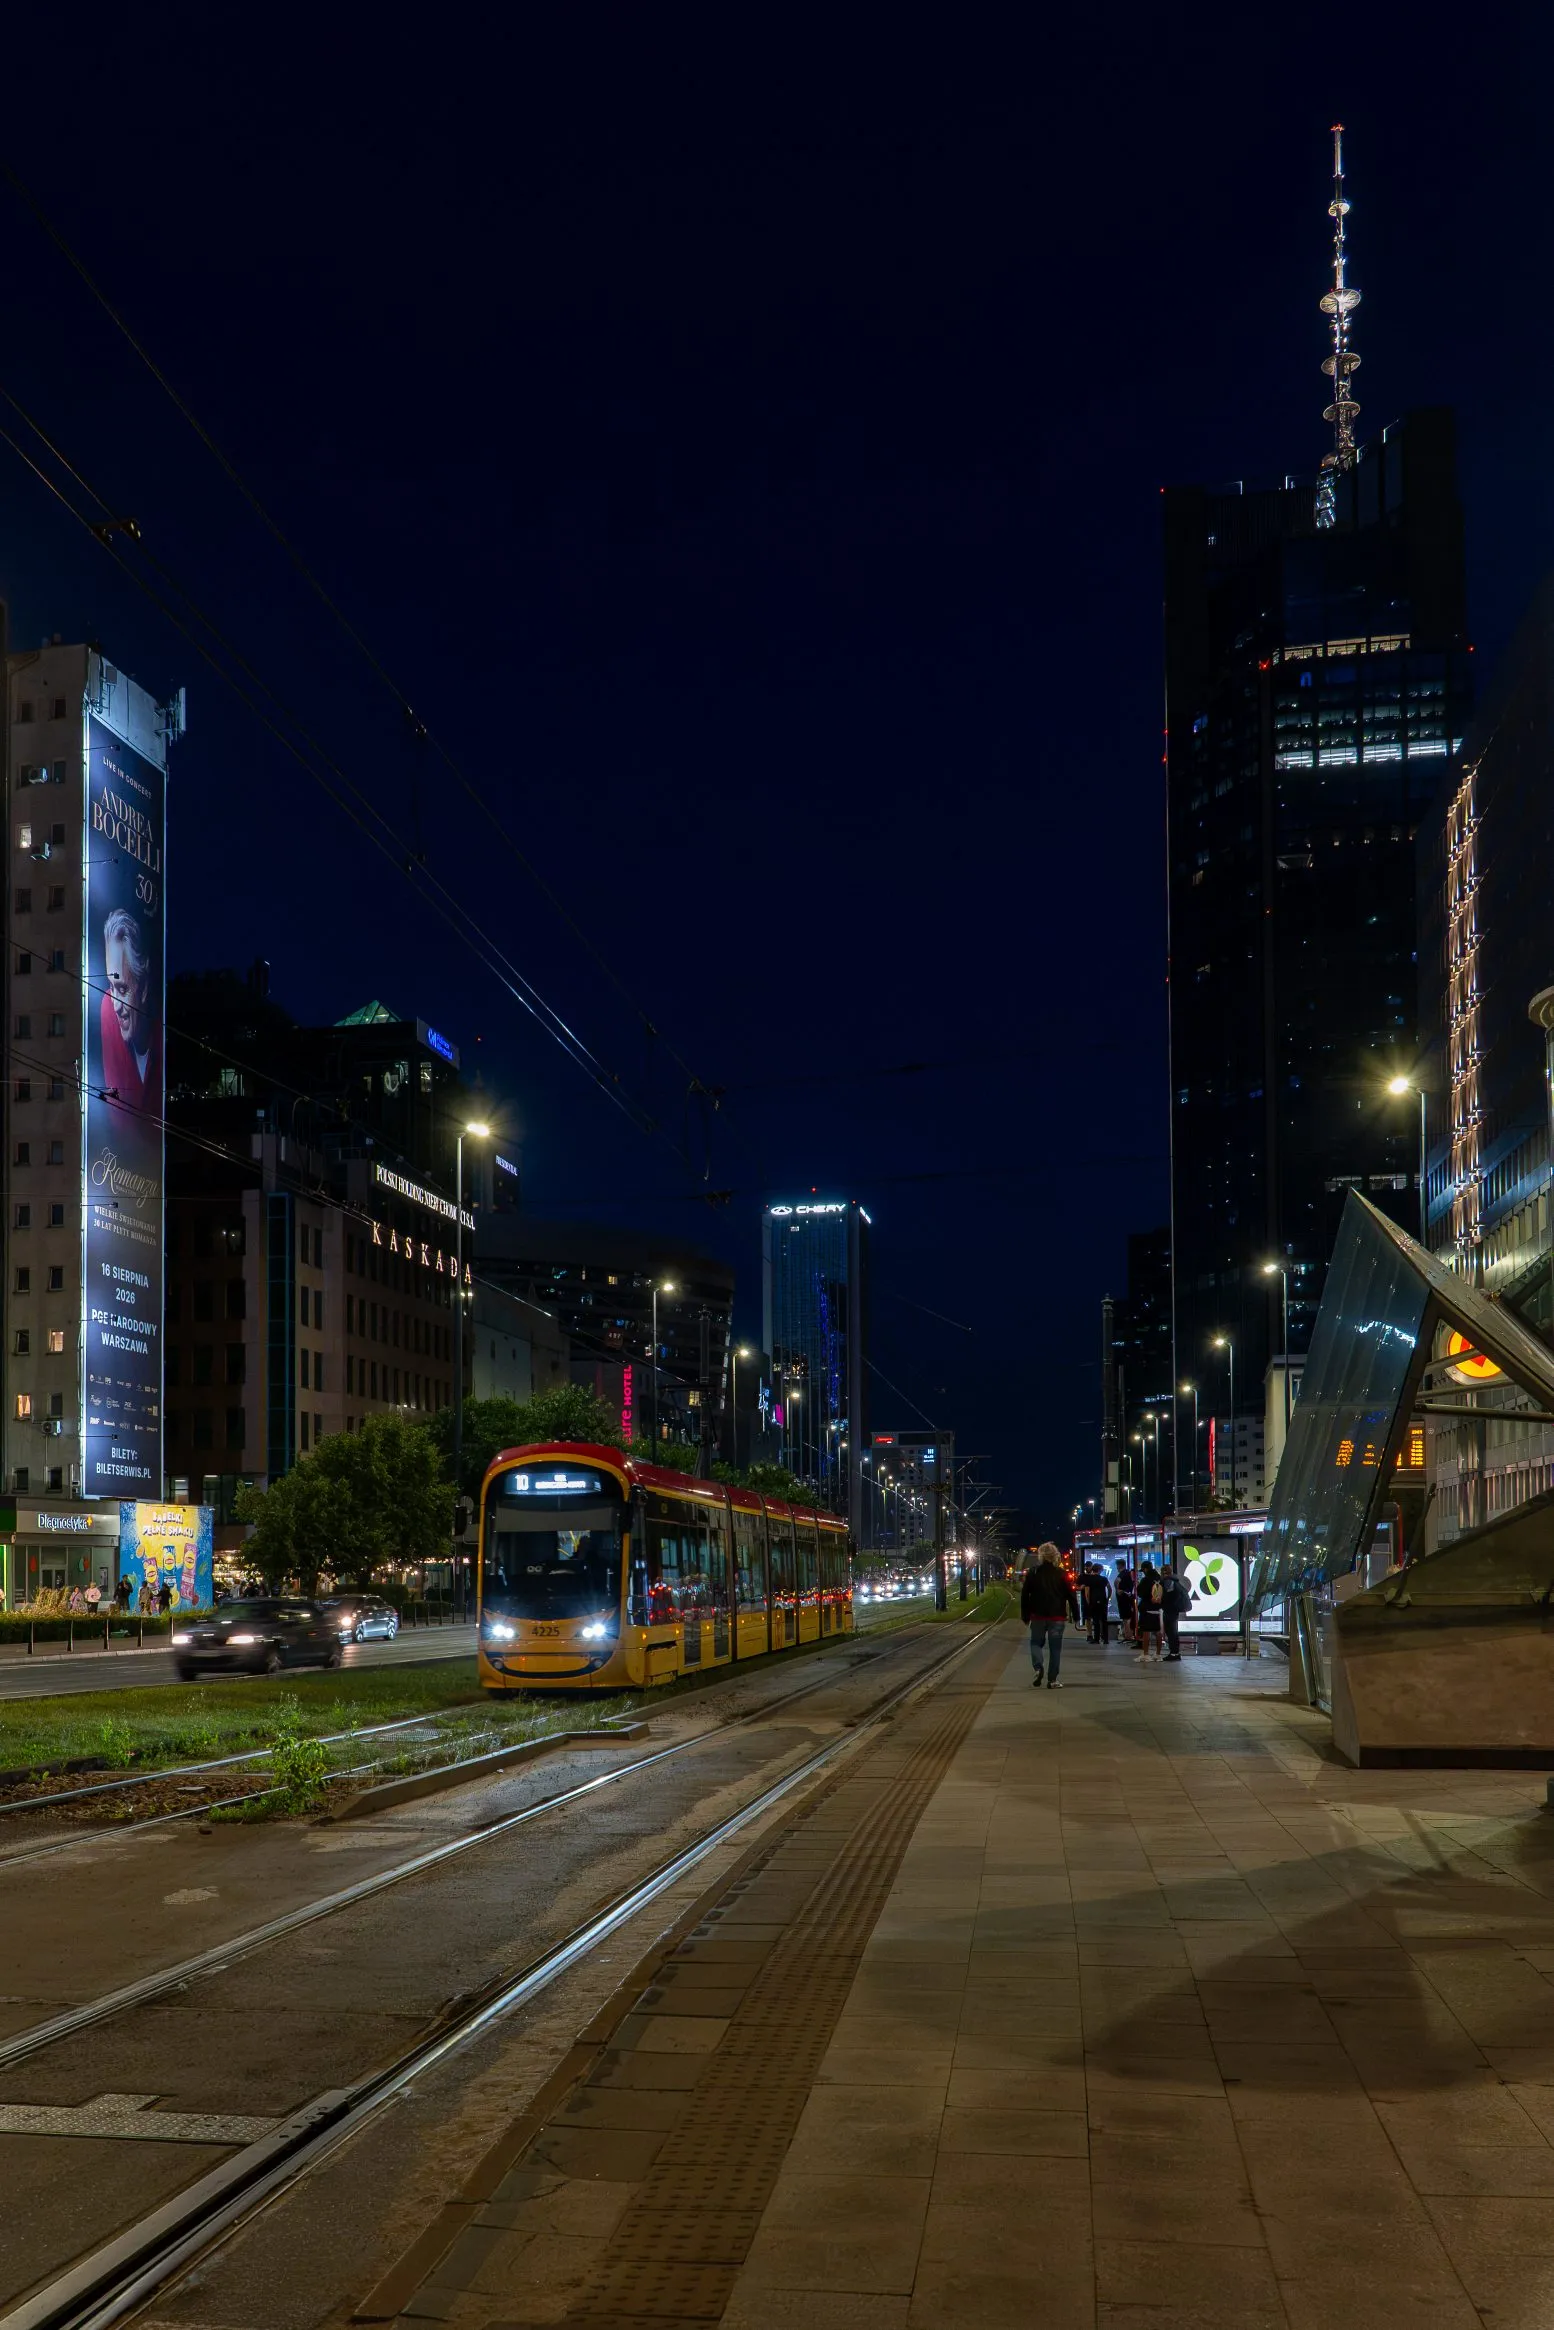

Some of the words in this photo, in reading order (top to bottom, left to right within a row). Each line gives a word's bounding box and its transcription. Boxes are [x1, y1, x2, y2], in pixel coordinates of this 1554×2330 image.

[103, 756, 116, 773] LIVE
[117, 768, 124, 779] IN
[125, 774, 152, 799] CONCERT
[101, 786, 153, 842] ANDREA
[92, 801, 160, 873] BOCELLI
[92, 1147, 158, 1208] Romanza
[377, 1165, 398, 1190] POLSKI
[398, 1176, 424, 1204] HOLDING
[94, 1204, 118, 1220] WIELKIE
[796, 1203, 846, 1214] CHERY
[93, 1218, 100, 1227] 30
[101, 1220, 112, 1232] LAT
[373, 1221, 471, 1284] KASKADA
[101, 1263, 111, 1277] 16
[112, 1266, 149, 1288] SIERPNIA
[115, 1287, 136, 1304] 2026
[92, 1308, 108, 1324] PGE
[110, 1313, 157, 1336] NARODOWY
[101, 1331, 148, 1354] WARSZAWA
[623, 1364, 632, 1406] HOTEL
[111, 1447, 138, 1460] BILETY:
[96, 1462, 152, 1479] BILETSERWIS.PL
[515, 1474, 529, 1490] 10
[38, 1513, 88, 1532] Diagnostyka
[531, 1626, 560, 1636] 4225
